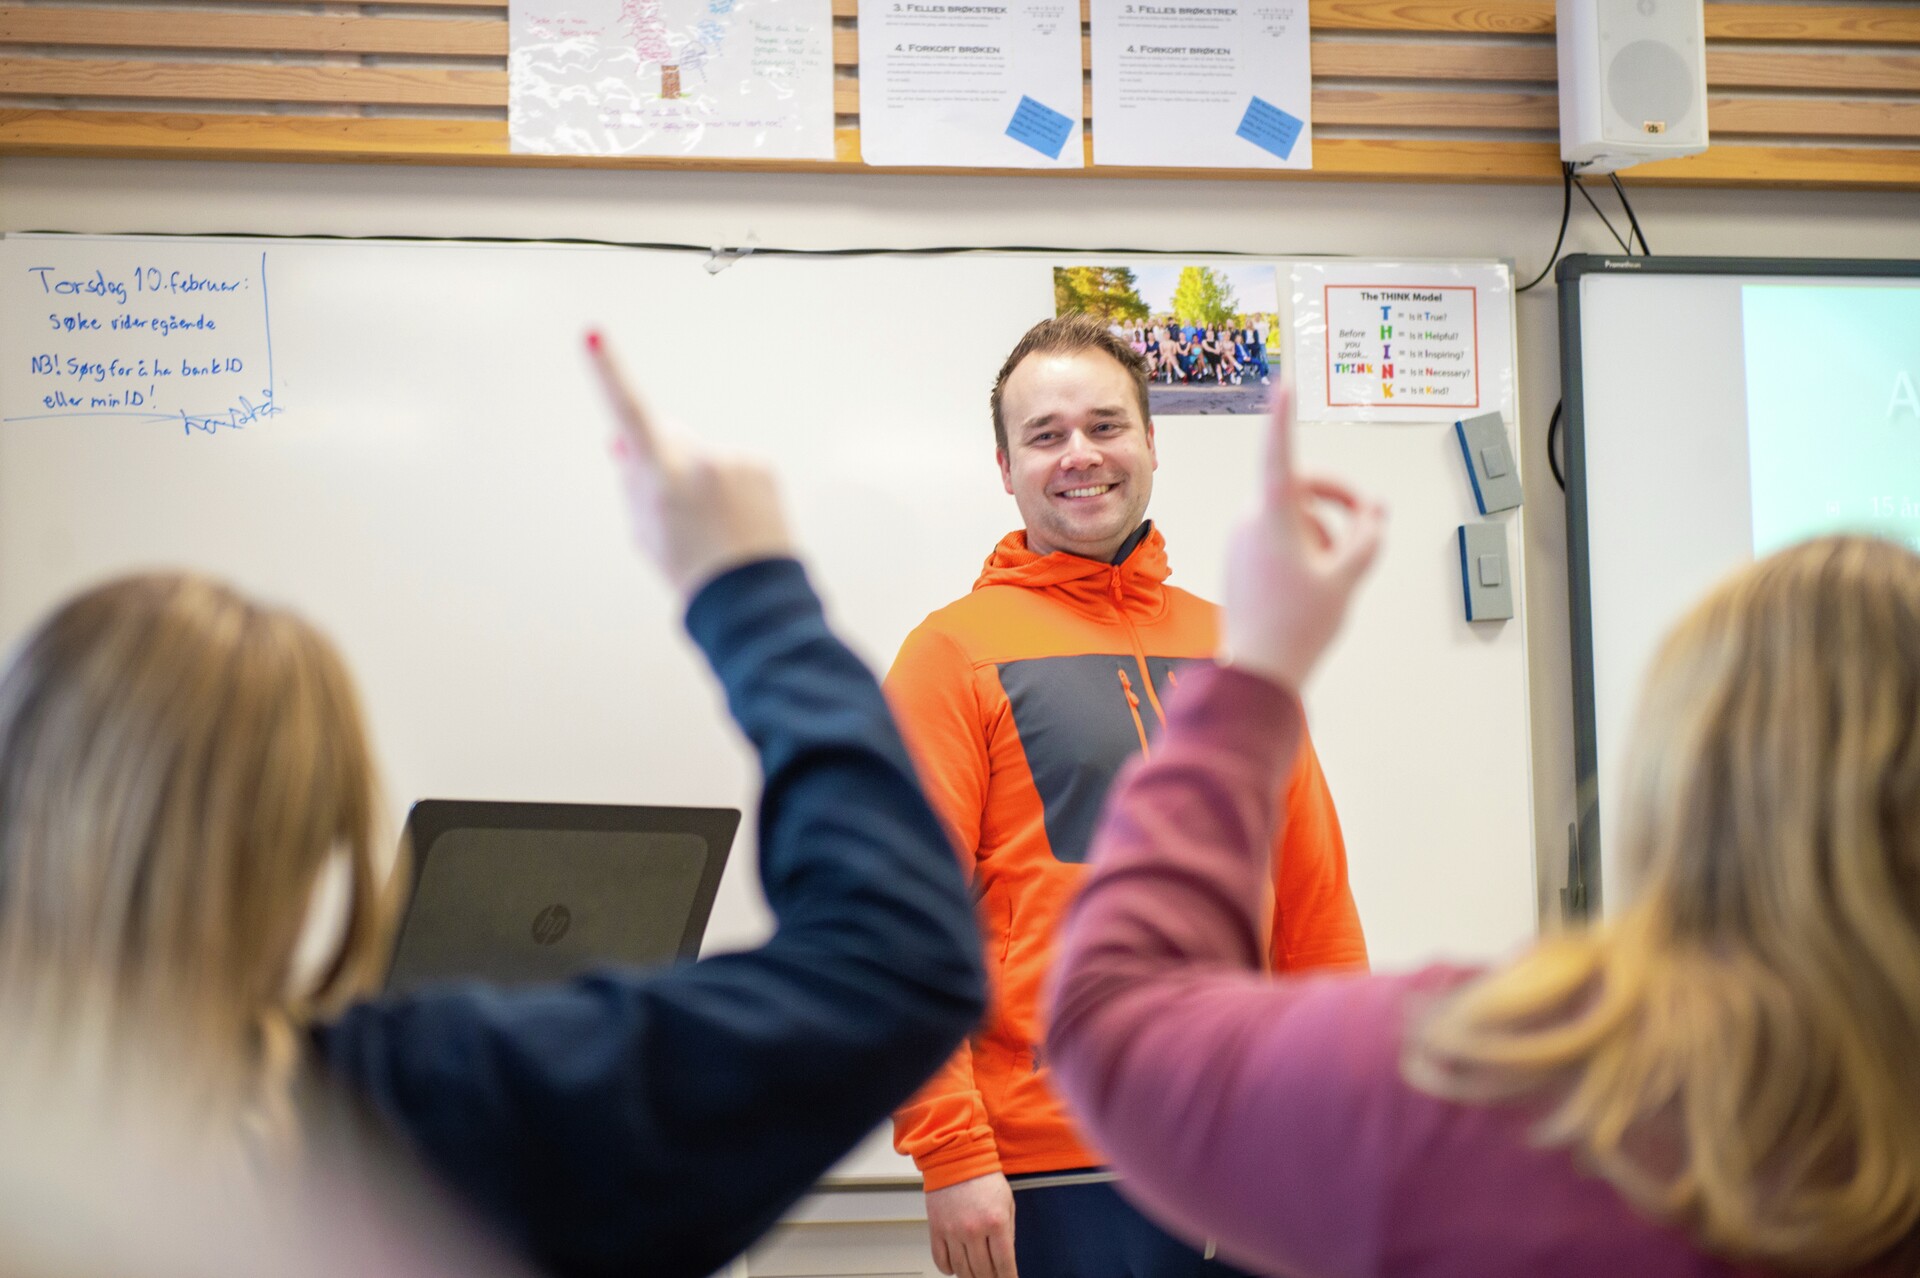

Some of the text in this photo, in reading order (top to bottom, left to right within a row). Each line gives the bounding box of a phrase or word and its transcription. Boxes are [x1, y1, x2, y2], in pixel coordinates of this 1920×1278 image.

[893, 3, 904, 13] 3.
[1125, 5, 1136, 14] 3.
[894, 44, 906, 52] 4.
[1127, 45, 1137, 54] 4.
[28, 267, 127, 305] Torsdag
[1361, 292, 1442, 302] The THINK Model
[1380, 305, 1392, 321] T
[1424, 312, 1447, 321] True?
[1339, 329, 1366, 338] Before
[1380, 325, 1392, 340] H
[1425, 331, 1459, 341] Helpful?
[1345, 341, 1361, 350] you
[1383, 344, 1391, 359] I
[1425, 350, 1464, 360] Inspiring?
[32, 354, 61, 375] NB!
[66, 357, 106, 382] Sørg
[109, 358, 133, 376] for
[138, 360, 148, 376] å
[154, 358, 172, 376] ha
[1335, 363, 1373, 374] THINK
[1382, 363, 1394, 379] N
[1426, 368, 1470, 379] Necessary?
[1382, 383, 1394, 399] K
[1411, 387, 1417, 395] Is
[1425, 386, 1449, 395] Kind?
[43, 390, 83, 409] eller
[1871, 496, 1895, 517] 15
